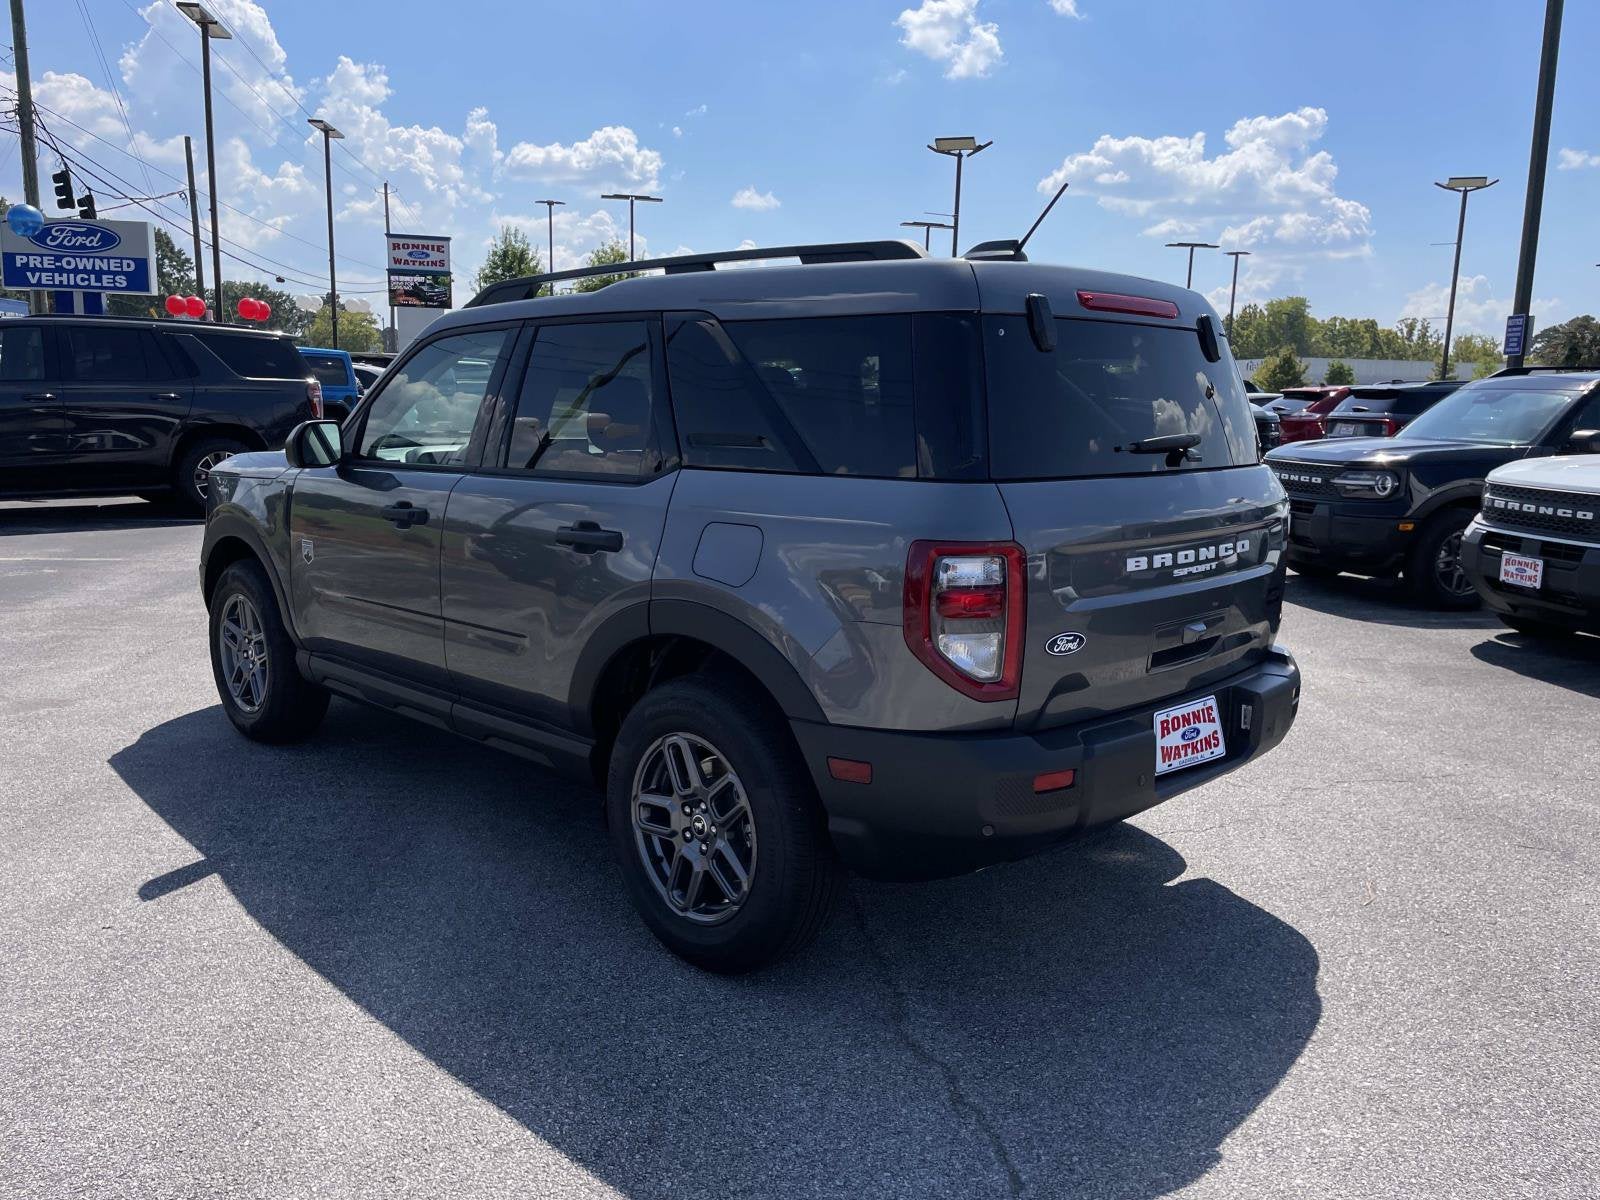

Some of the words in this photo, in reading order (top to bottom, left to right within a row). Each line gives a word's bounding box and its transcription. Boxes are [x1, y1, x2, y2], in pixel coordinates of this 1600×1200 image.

[46, 226, 102, 247] Ford
[391, 242, 445, 254] RONNIE
[15, 255, 136, 272] PRE-OWNED
[392, 256, 446, 268] WATKINS
[26, 271, 128, 288] VEHICLES
[1494, 499, 1594, 520] BRONCO
[1126, 539, 1250, 572] BRONCO
[1172, 561, 1217, 577] SPORT
[1504, 557, 1540, 573] RONNIE
[1503, 568, 1538, 584] WATKINS
[1054, 636, 1079, 652] Ford
[1160, 705, 1216, 740] RONNIE
[1184, 729, 1198, 739] Ford
[1160, 729, 1220, 764] WATKINS
